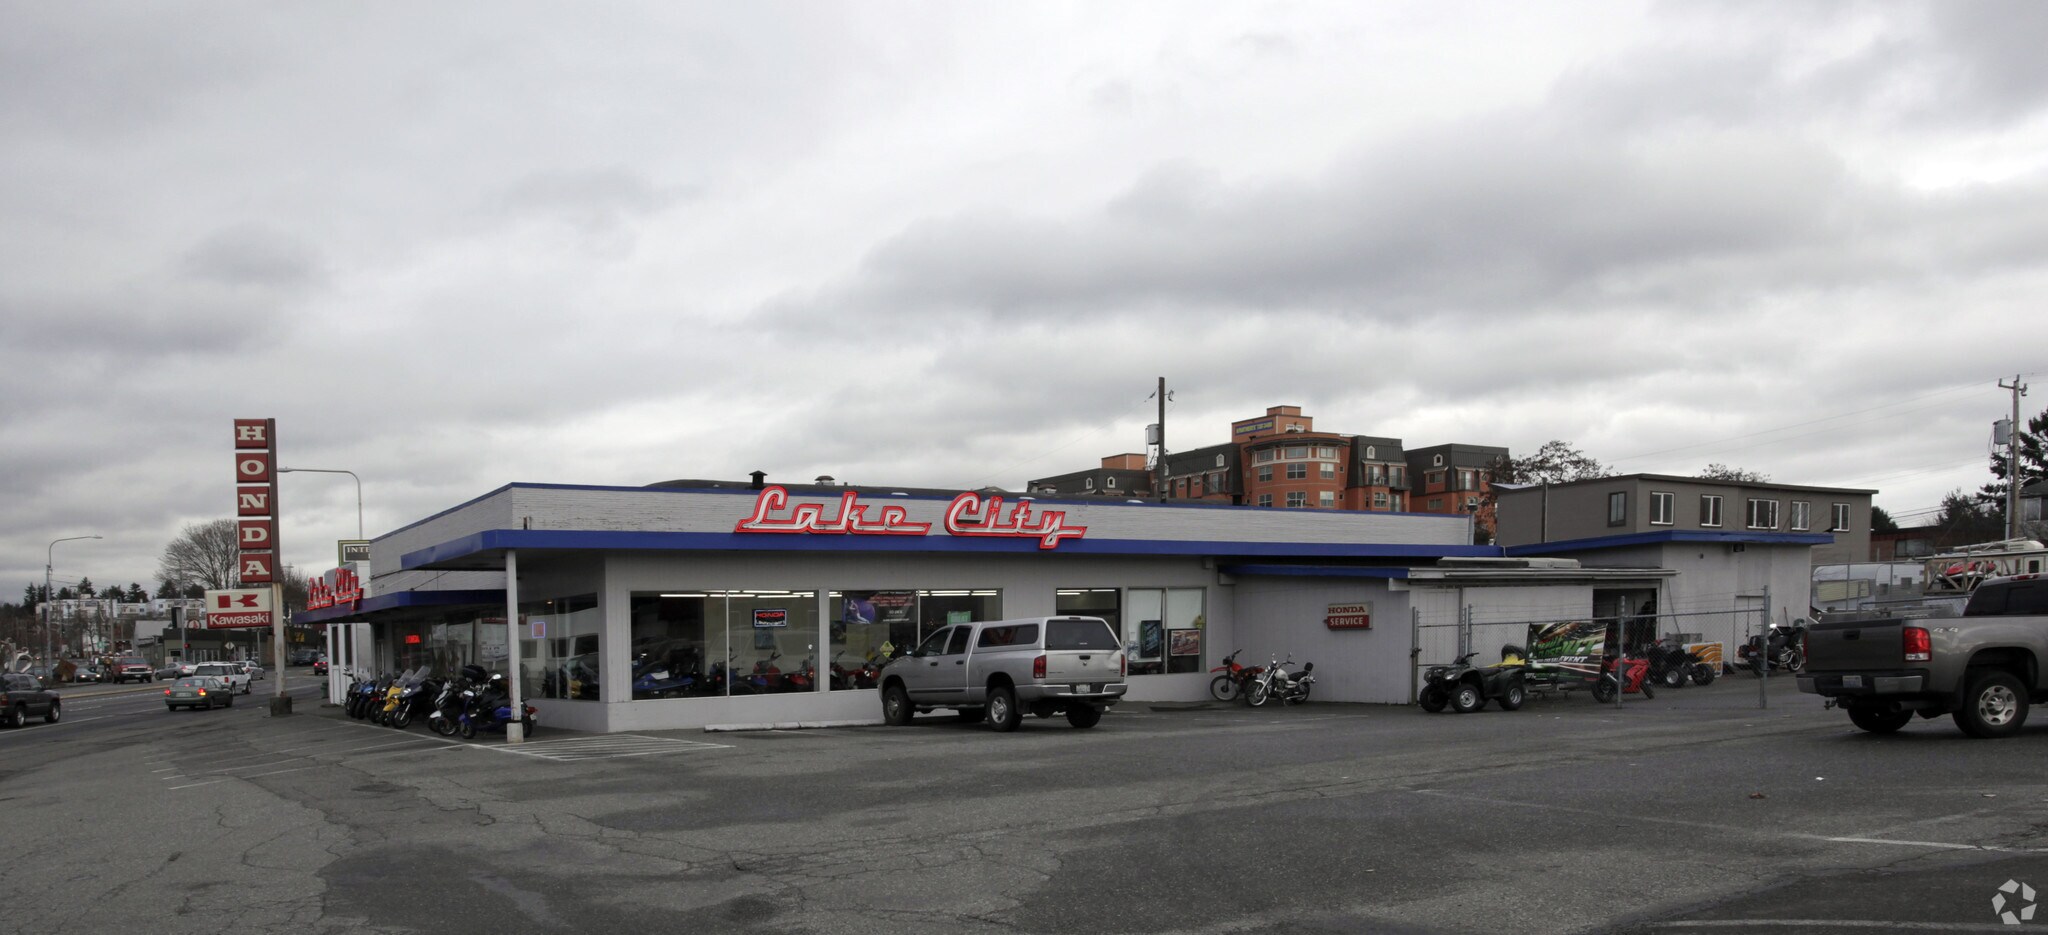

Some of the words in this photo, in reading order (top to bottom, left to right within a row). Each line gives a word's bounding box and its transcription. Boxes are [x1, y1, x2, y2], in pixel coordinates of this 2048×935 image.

[237, 425, 269, 576] HONDA
[734, 486, 932, 534] Lake
[945, 491, 1088, 550] City
[1328, 606, 1365, 614] HONDA
[209, 612, 269, 626] Kawasaki
[1330, 616, 1364, 626] SERVICE
[1558, 655, 1588, 663] EVENT
